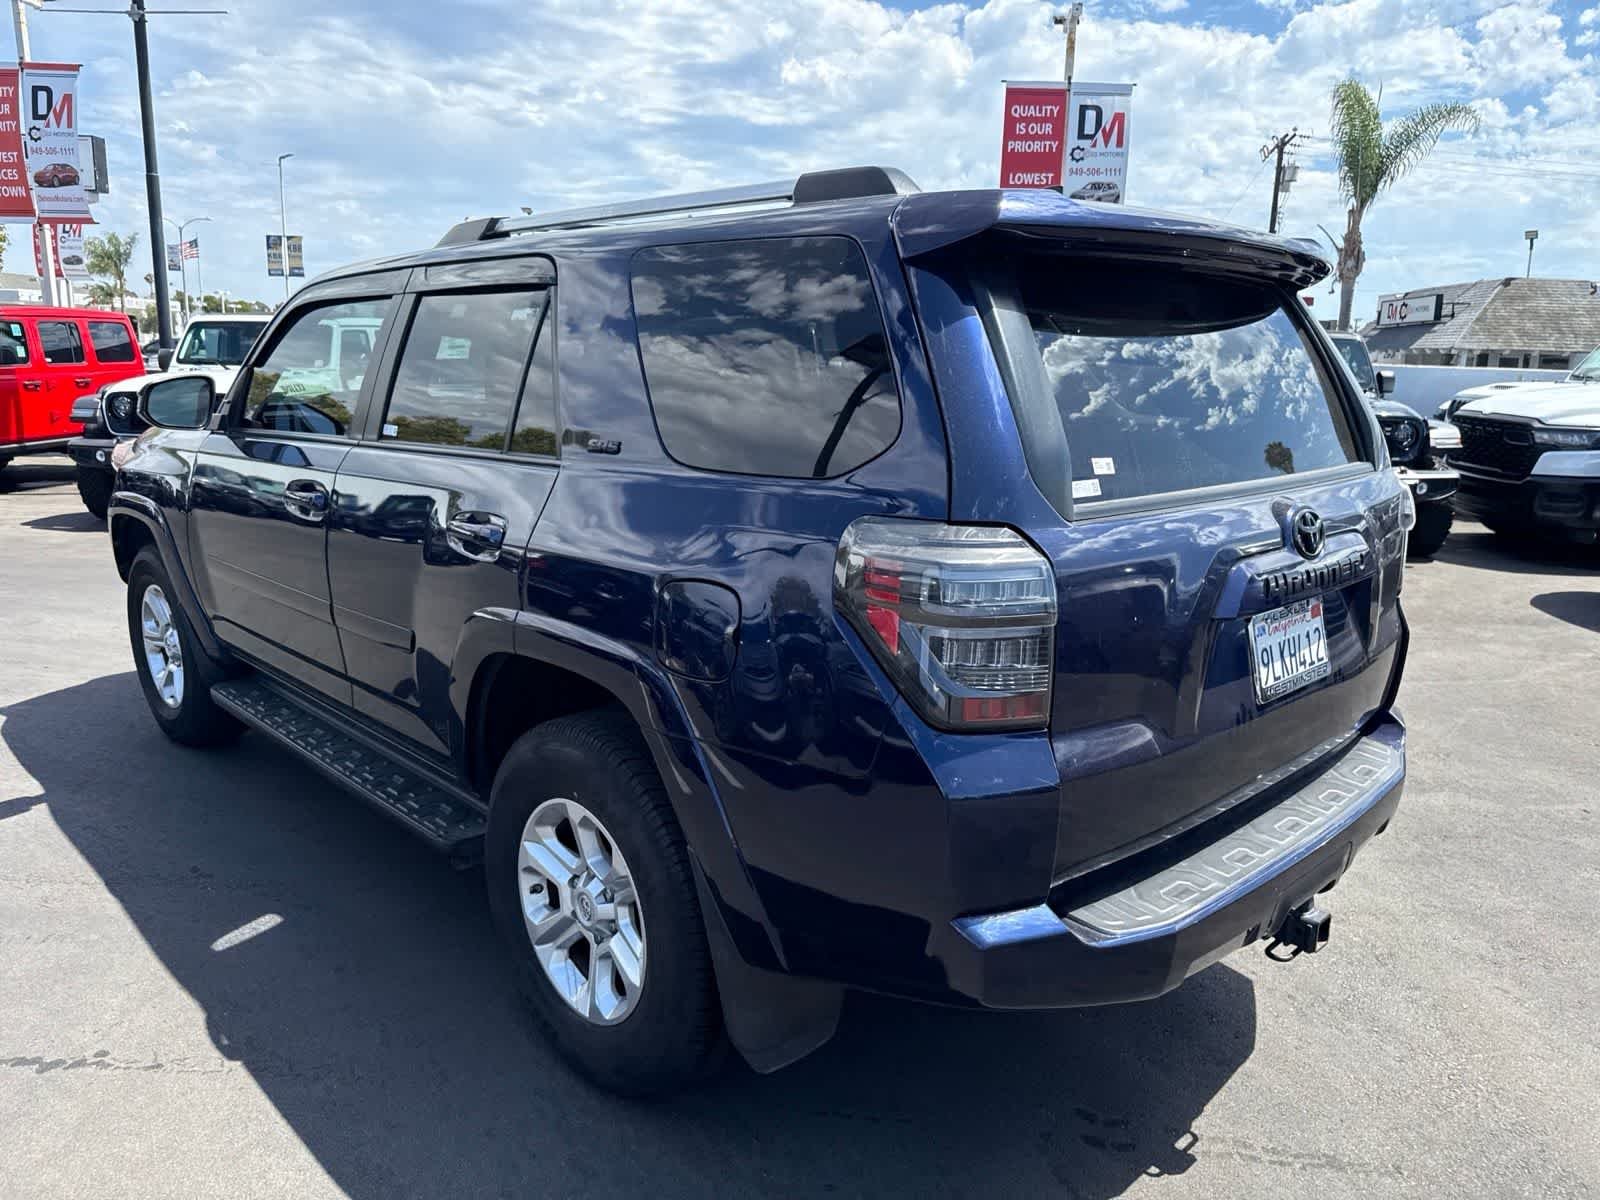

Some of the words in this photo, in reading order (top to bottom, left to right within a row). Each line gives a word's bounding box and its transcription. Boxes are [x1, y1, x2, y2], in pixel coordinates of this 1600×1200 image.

[1011, 104, 1060, 118] QUALITY
[1016, 122, 1026, 135] IS
[1028, 123, 1053, 135] OUR
[1007, 141, 1058, 153] PRIORITY
[1068, 167, 1121, 177] 949-506-1111
[1009, 173, 1054, 185] LOWEST
[1261, 627, 1325, 686] 9LKH412
[1266, 664, 1328, 697] WESTMINSTER
